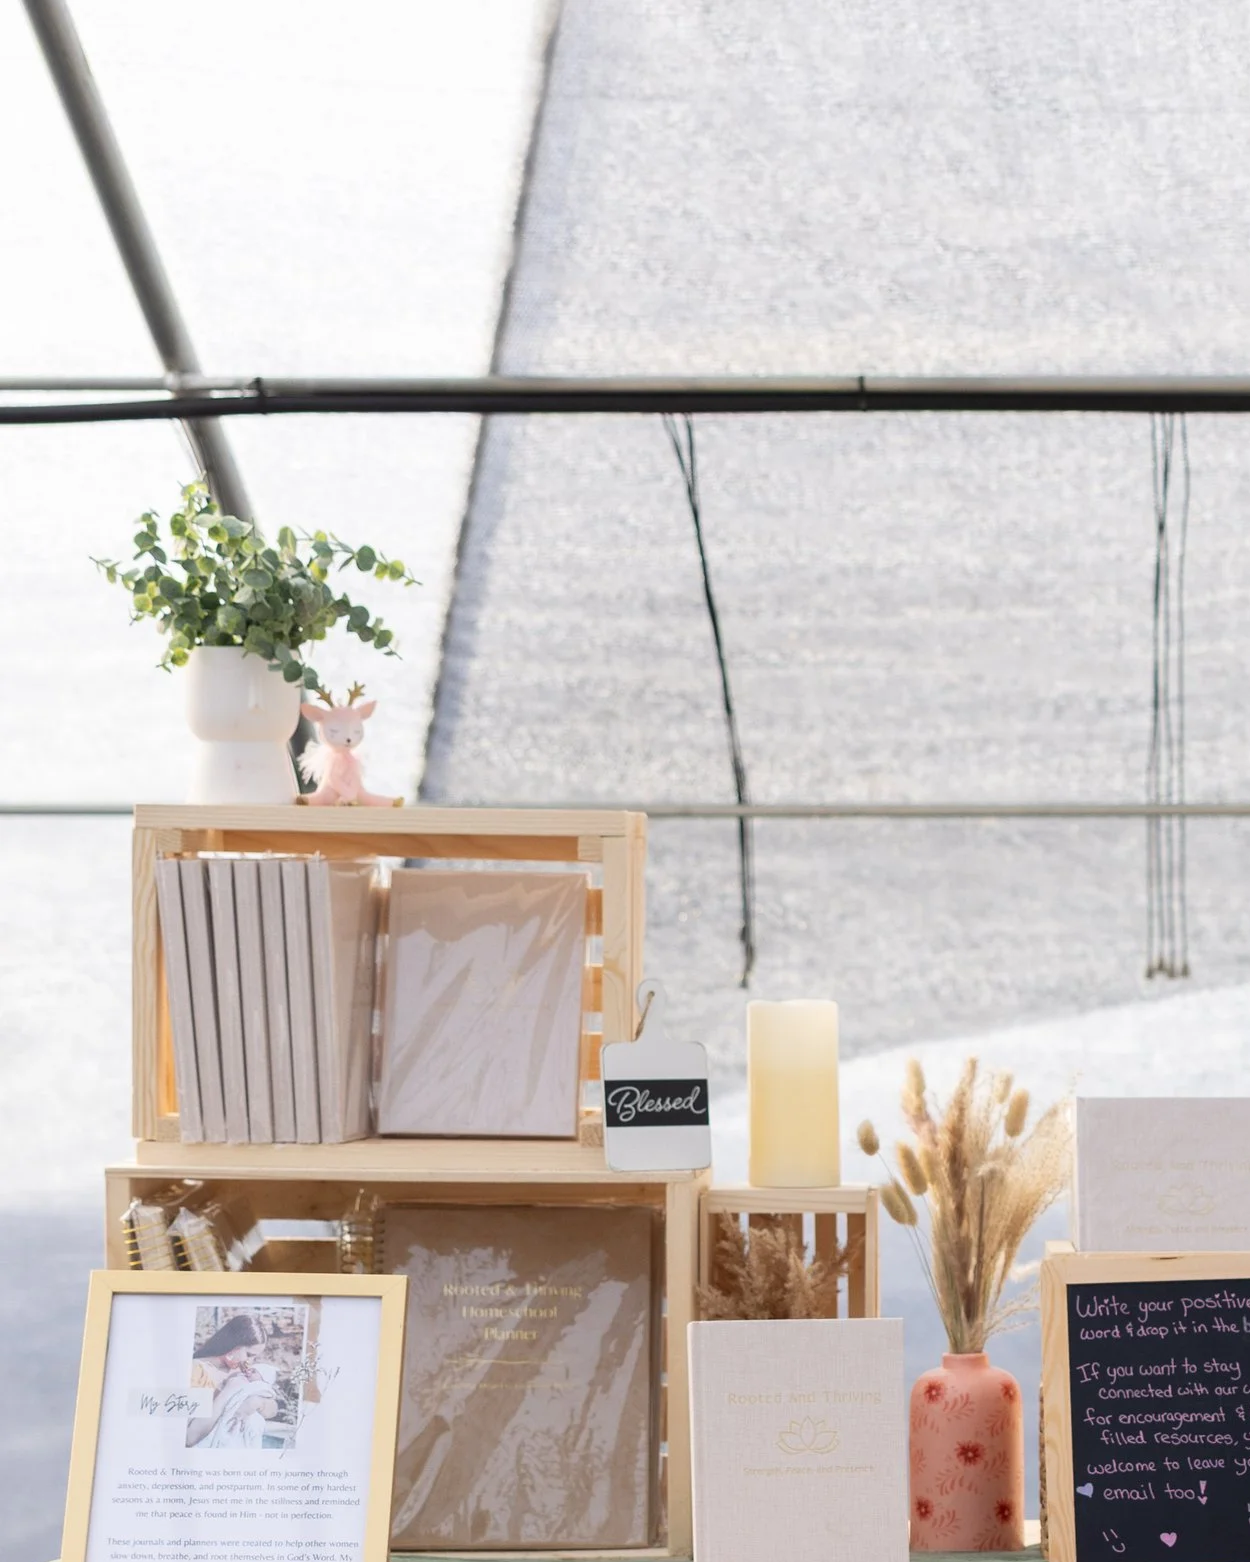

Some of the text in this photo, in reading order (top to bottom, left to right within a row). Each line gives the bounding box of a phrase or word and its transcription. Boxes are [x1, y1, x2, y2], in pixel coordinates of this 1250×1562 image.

[608, 1086, 706, 1122] Blessed
[1075, 1295, 1130, 1317] Write
[1139, 1299, 1174, 1323] your
[1080, 1325, 1120, 1341] word
[1137, 1325, 1168, 1340] drop
[1173, 1321, 1188, 1334] it
[1192, 1321, 1208, 1334] in
[1213, 1319, 1240, 1334] the
[1076, 1358, 1241, 1384] If you want to stay
[1098, 1382, 1173, 1400] connected
[1178, 1382, 1209, 1396] with
[1215, 1384, 1238, 1395] our
[140, 1393, 199, 1415] My Story
[1083, 1409, 1113, 1425] for
[1119, 1410, 1226, 1429] encouragement
[1101, 1430, 1147, 1445] filled
[1154, 1433, 1238, 1447] resources,
[1087, 1456, 1156, 1475] welcome
[1163, 1456, 1180, 1470] to
[1187, 1451, 1226, 1469] leave
[128, 1468, 157, 1476] Rooted
[160, 1468, 167, 1476] &
[171, 1468, 203, 1477] Thriving
[222, 1468, 241, 1476] born
[285, 1470, 314, 1478] journey
[317, 1470, 348, 1479] through
[1103, 1483, 1156, 1500] email
[106, 1537, 130, 1546] These
[132, 1538, 164, 1547] journals
[184, 1539, 217, 1547] planners
[285, 1540, 303, 1548] help
[131, 1552, 155, 1560] down,
[340, 1554, 353, 1562] My
